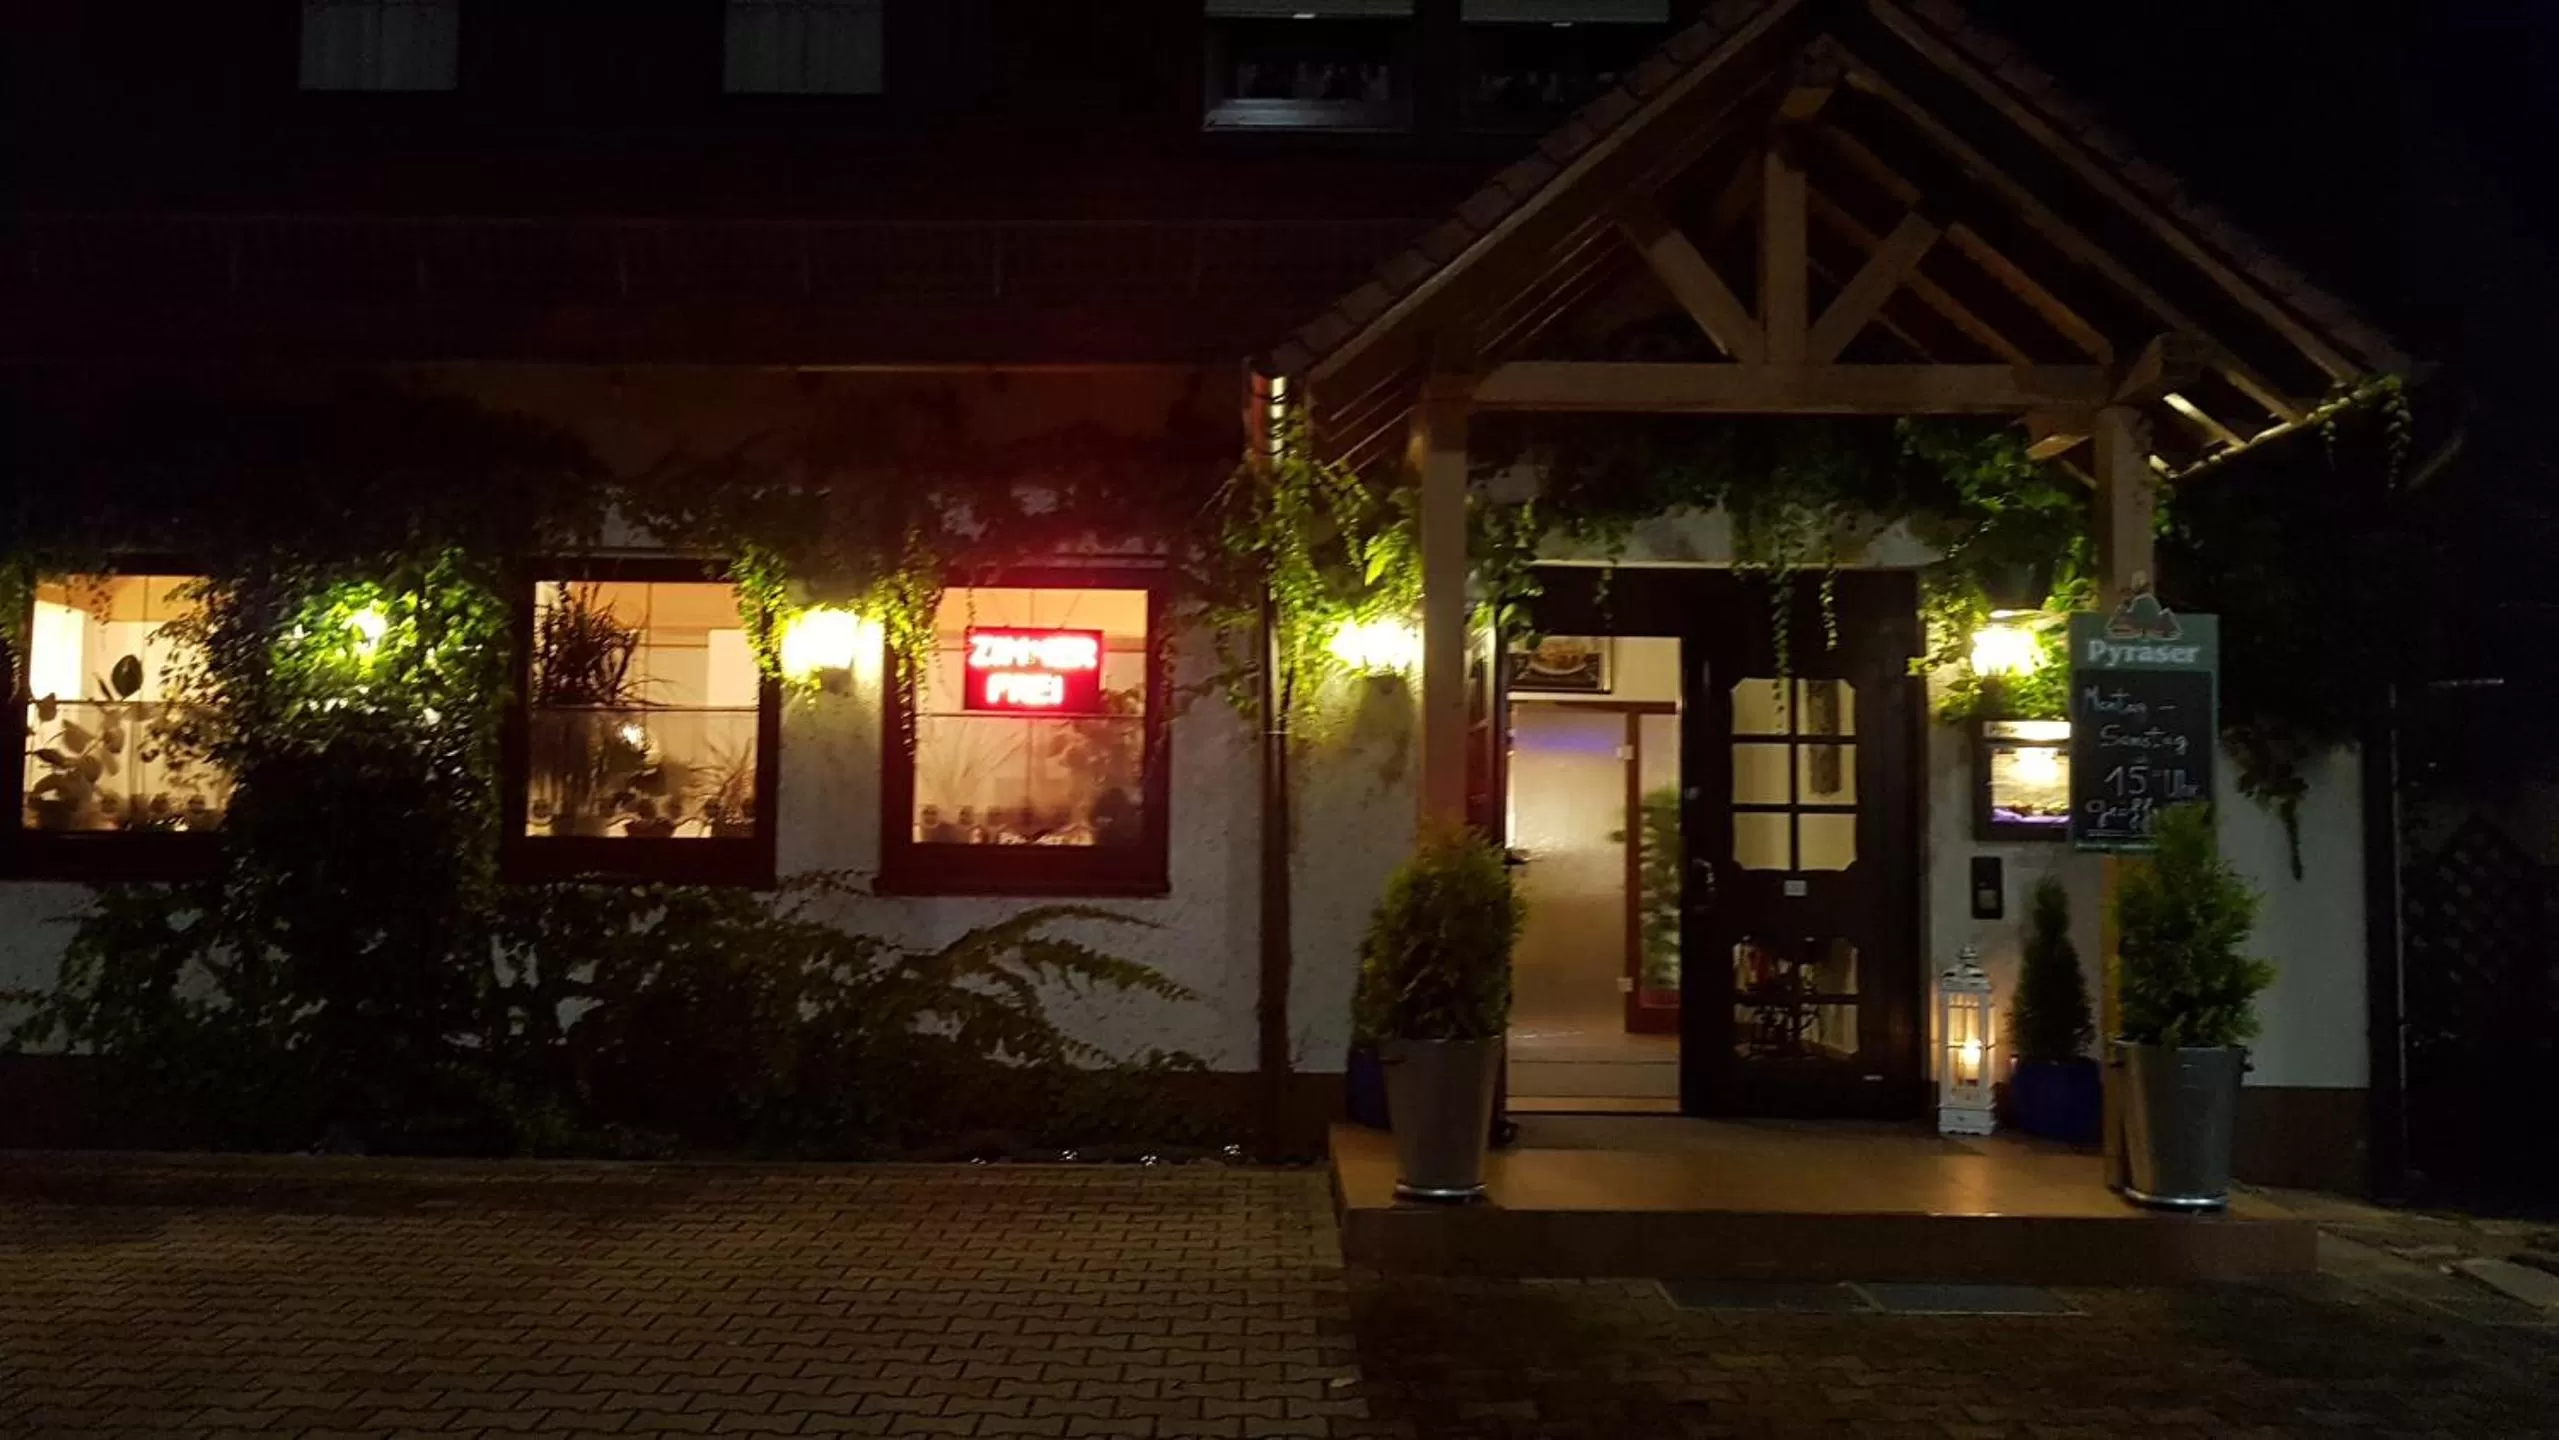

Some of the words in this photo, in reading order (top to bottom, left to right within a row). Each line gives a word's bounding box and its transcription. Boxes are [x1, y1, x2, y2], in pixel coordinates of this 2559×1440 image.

[968, 635, 1098, 669] ZIMMER
[2087, 639, 2201, 667] Pyraser
[2099, 724, 2190, 756] Samstag
[2103, 765, 2149, 798] 15
